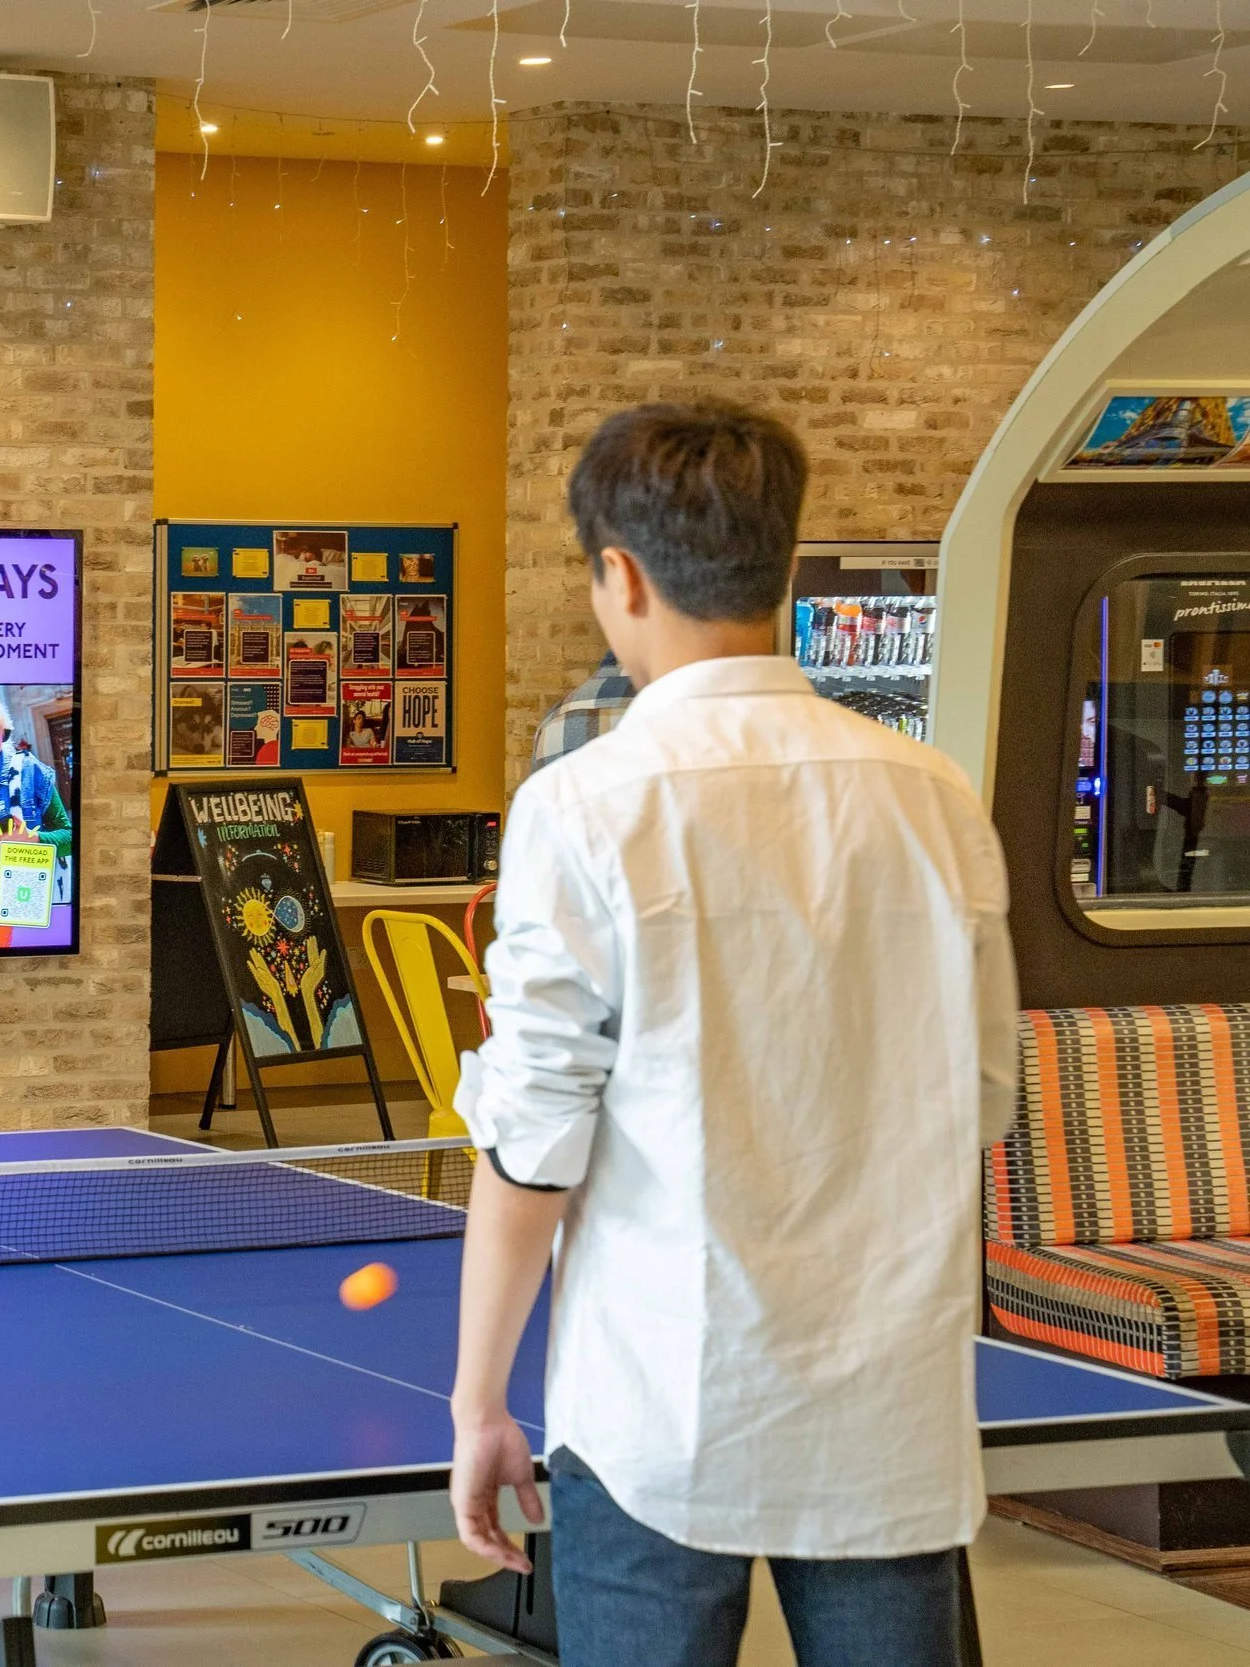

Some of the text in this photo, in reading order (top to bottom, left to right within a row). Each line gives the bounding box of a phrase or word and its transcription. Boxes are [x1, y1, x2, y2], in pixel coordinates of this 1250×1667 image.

[1173, 598, 1250, 621] prontissim
[402, 686, 439, 694] CHOOSE
[402, 695, 439, 728] HOPE
[190, 792, 295, 824] WELLBEING
[216, 824, 281, 842] INFORMATION
[7, 848, 48, 856] DOWNLOAD
[141, 1514, 350, 1551] cornilleau 500
